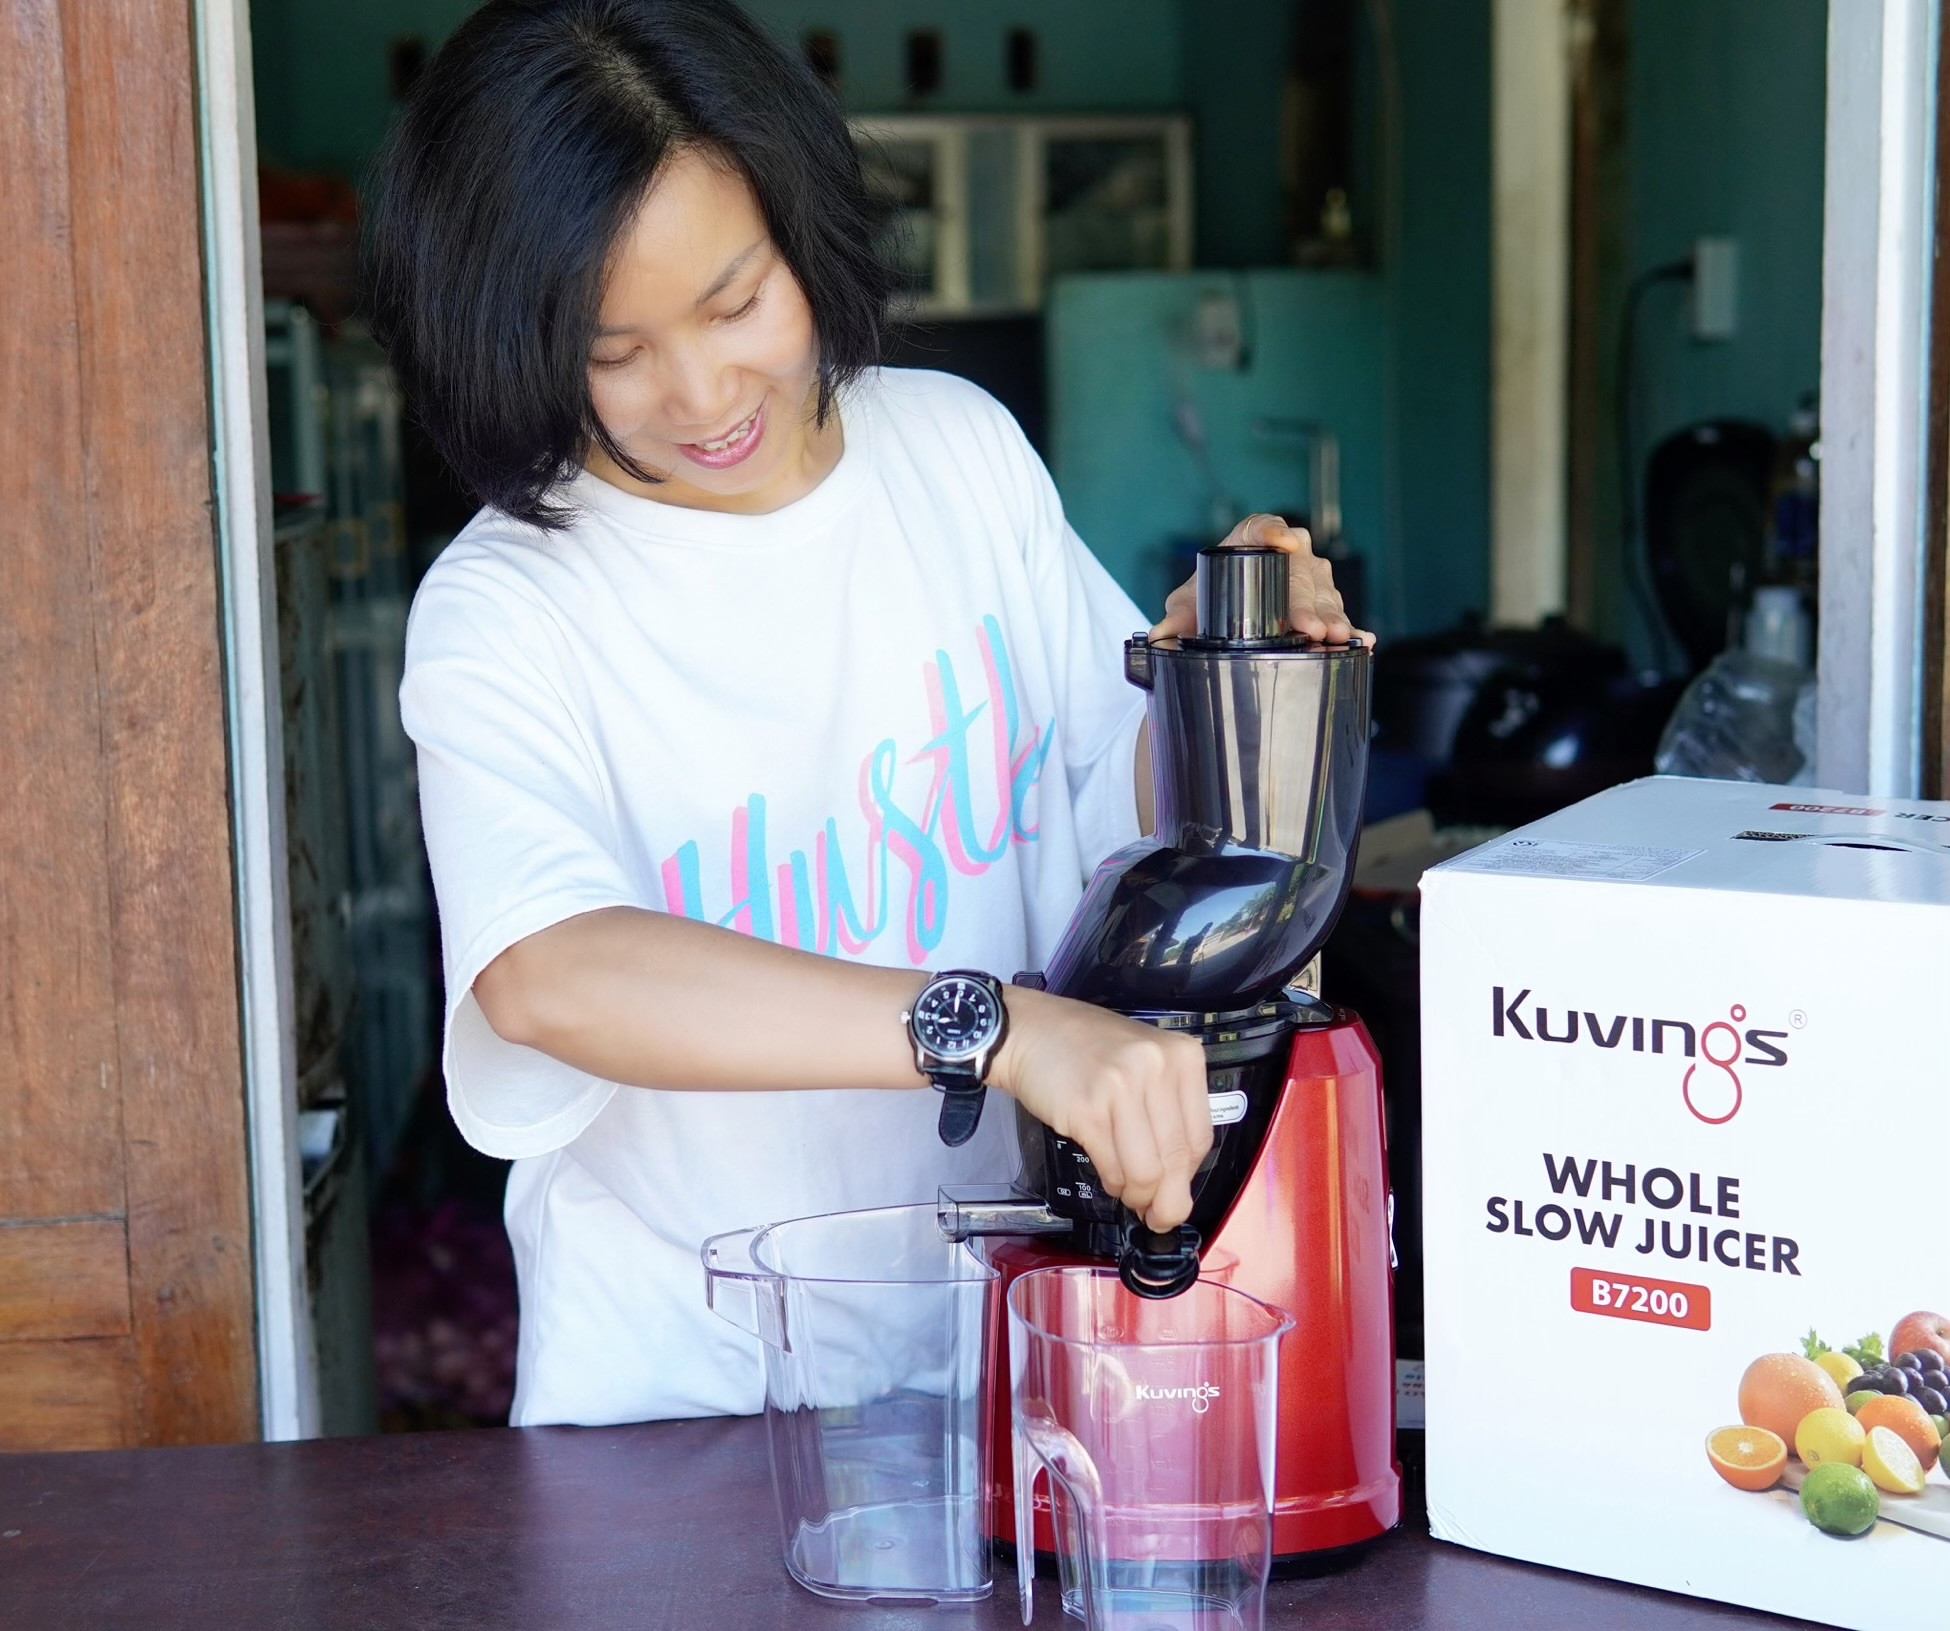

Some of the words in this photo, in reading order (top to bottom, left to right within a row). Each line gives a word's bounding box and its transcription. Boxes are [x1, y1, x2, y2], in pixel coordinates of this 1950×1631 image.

[1894, 812, 1950, 822] CER
[1492, 986, 1789, 1124] Kuvings
[1543, 1153, 1740, 1219] WHOLE
[1486, 1196, 1623, 1248] SLOW
[1635, 1217, 1802, 1276] JUICER
[1592, 1279, 1688, 1319] B7200
[1135, 1381, 1220, 1413] Kuvings
